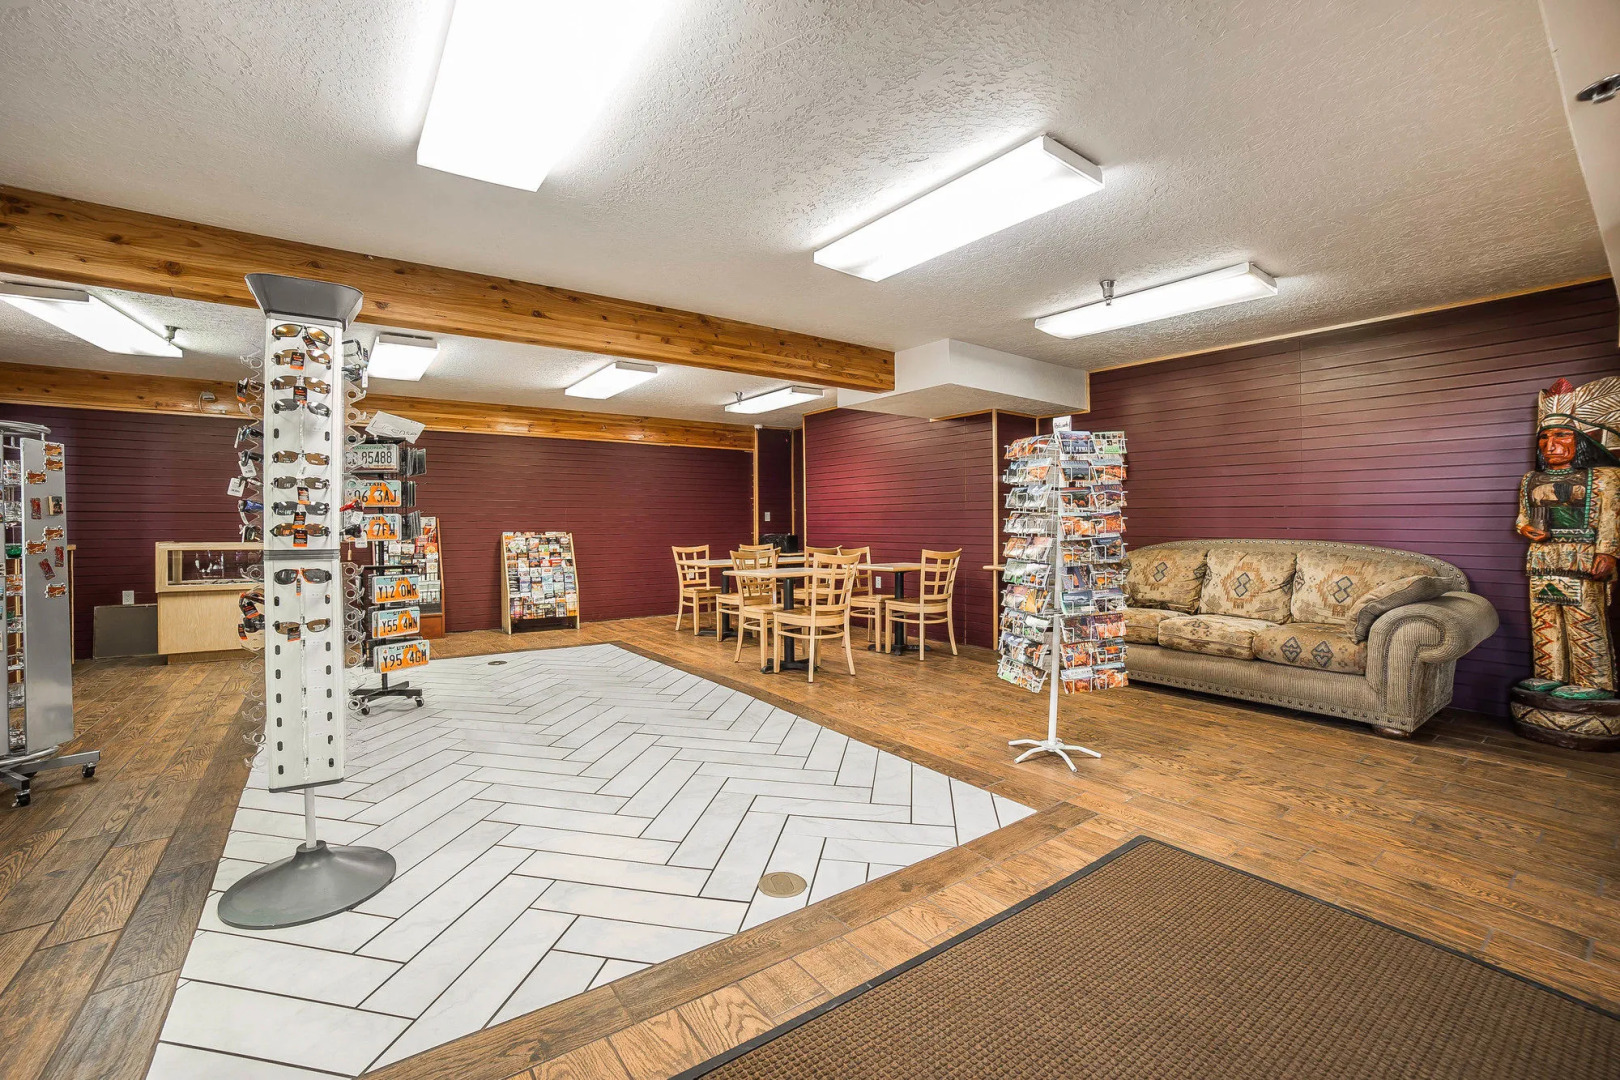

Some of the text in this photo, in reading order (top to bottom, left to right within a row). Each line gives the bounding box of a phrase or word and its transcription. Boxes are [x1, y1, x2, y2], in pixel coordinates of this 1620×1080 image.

[361, 451, 392, 464] 85488
[377, 489, 397, 503] 3AJ
[379, 585, 395, 598] Y12
[382, 619, 398, 633] Y55
[383, 649, 427, 668] Y95 4GM
